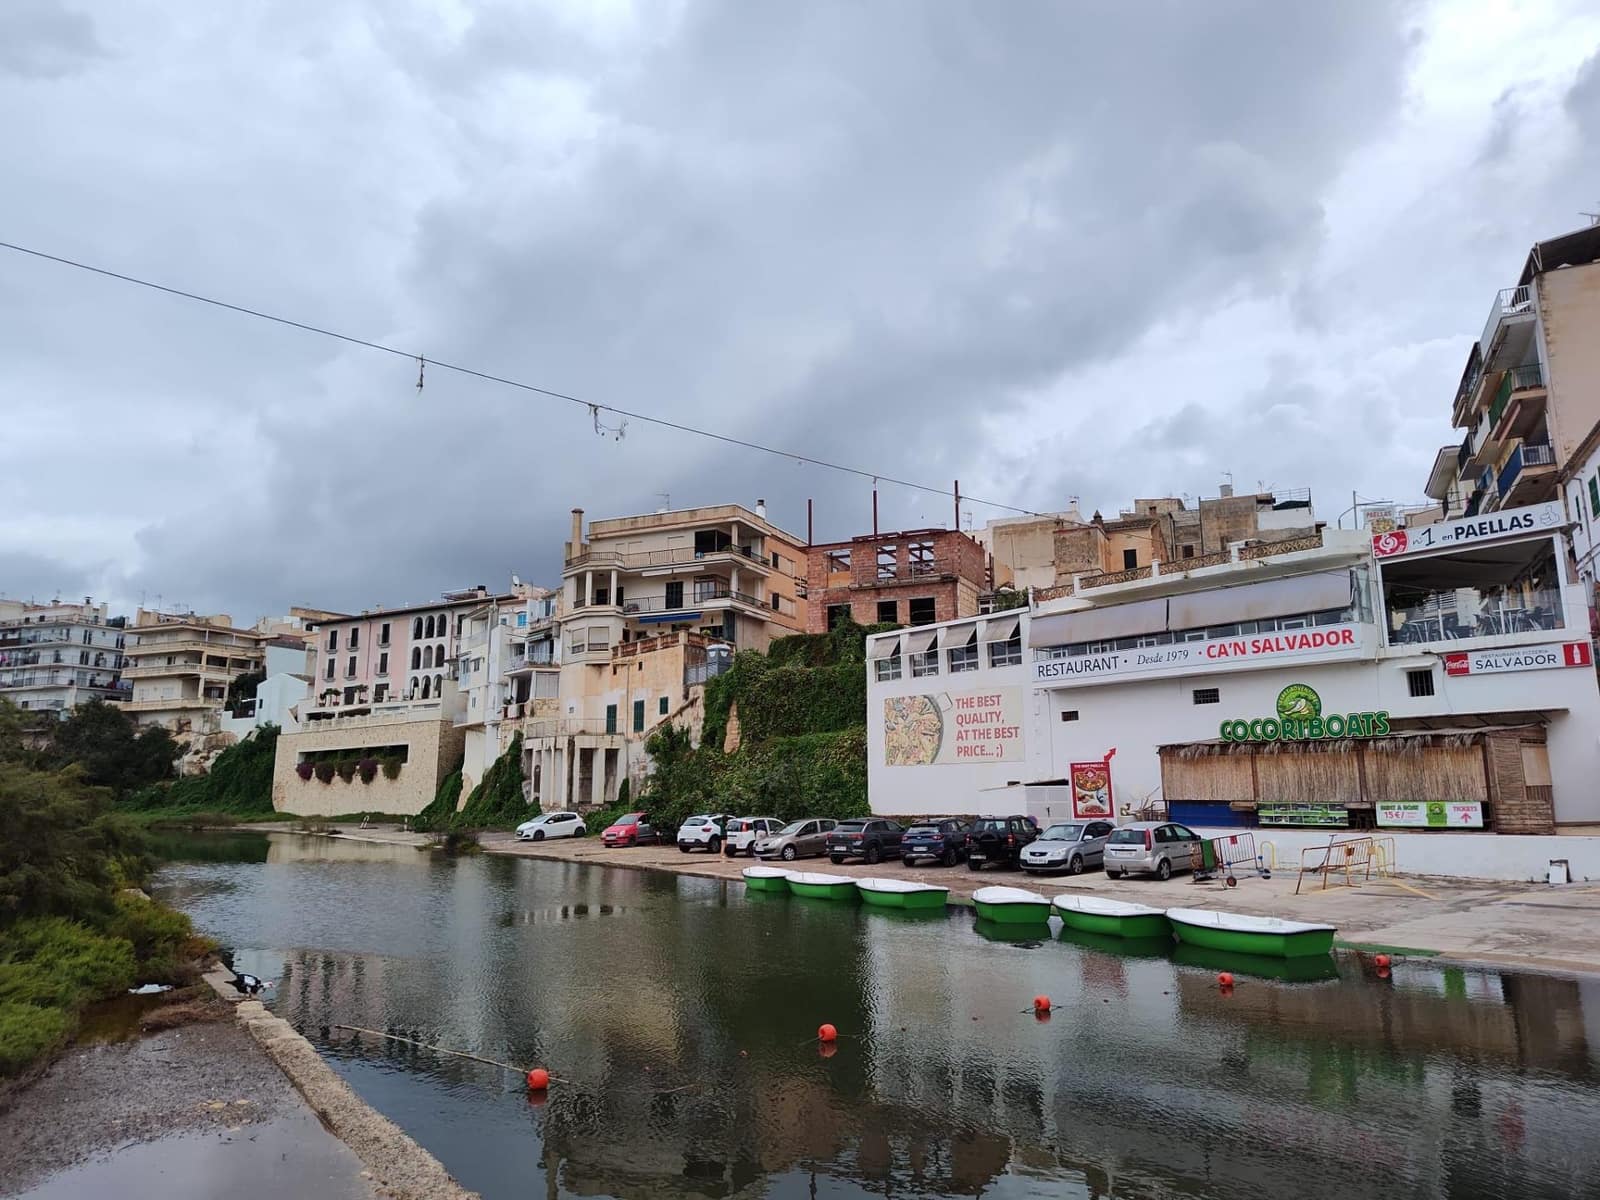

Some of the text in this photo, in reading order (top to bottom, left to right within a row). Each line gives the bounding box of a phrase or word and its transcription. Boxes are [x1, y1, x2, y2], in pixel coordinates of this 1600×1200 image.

[1421, 528, 1436, 547] 1
[1454, 513, 1535, 541] PAELLAS
[1037, 654, 1120, 677] RESTAURANT
[1137, 652, 1164, 666] Desde
[1166, 650, 1189, 664] 1979
[1251, 629, 1355, 654] SALVADOR
[1475, 654, 1558, 670] SALVADOR
[955, 694, 1002, 709] THE BEST
[955, 711, 1005, 726] QUALITY,
[956, 726, 1019, 741] AT THE BEST
